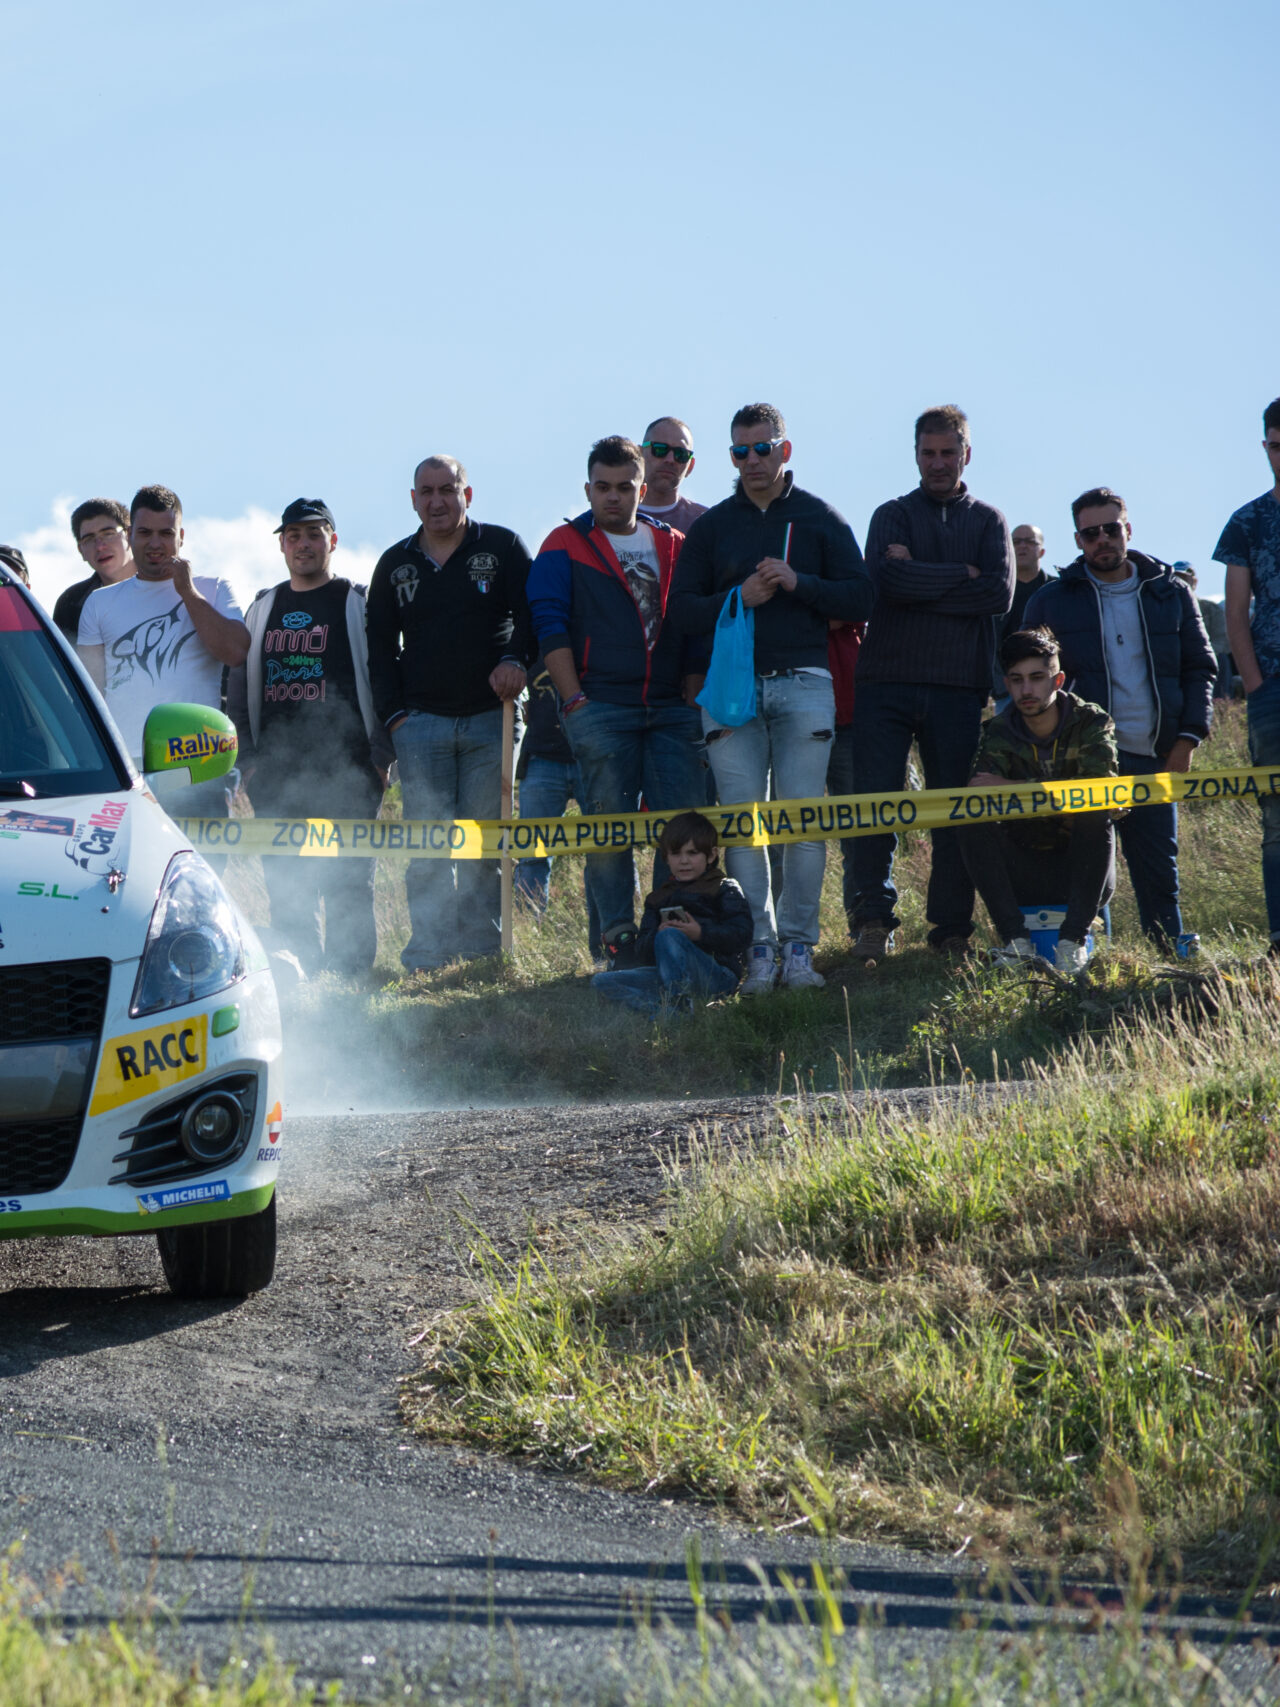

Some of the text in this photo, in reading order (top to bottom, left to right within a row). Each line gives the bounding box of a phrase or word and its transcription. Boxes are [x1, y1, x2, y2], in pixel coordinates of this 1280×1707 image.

[168, 732, 238, 756] Rallyca
[1183, 775, 1259, 799] ZONA
[949, 783, 1151, 820] ZONA PUBLICO
[79, 800, 128, 855] CarMax
[720, 799, 917, 838] ZONA PUBLICO
[178, 820, 242, 846] LICO
[272, 822, 466, 849] ZONA PUBLICO
[498, 818, 667, 850] ZONA PUBLIC
[17, 882, 80, 901] S.L.
[116, 1028, 200, 1081] RACC
[162, 1184, 225, 1205] MICHELIN
